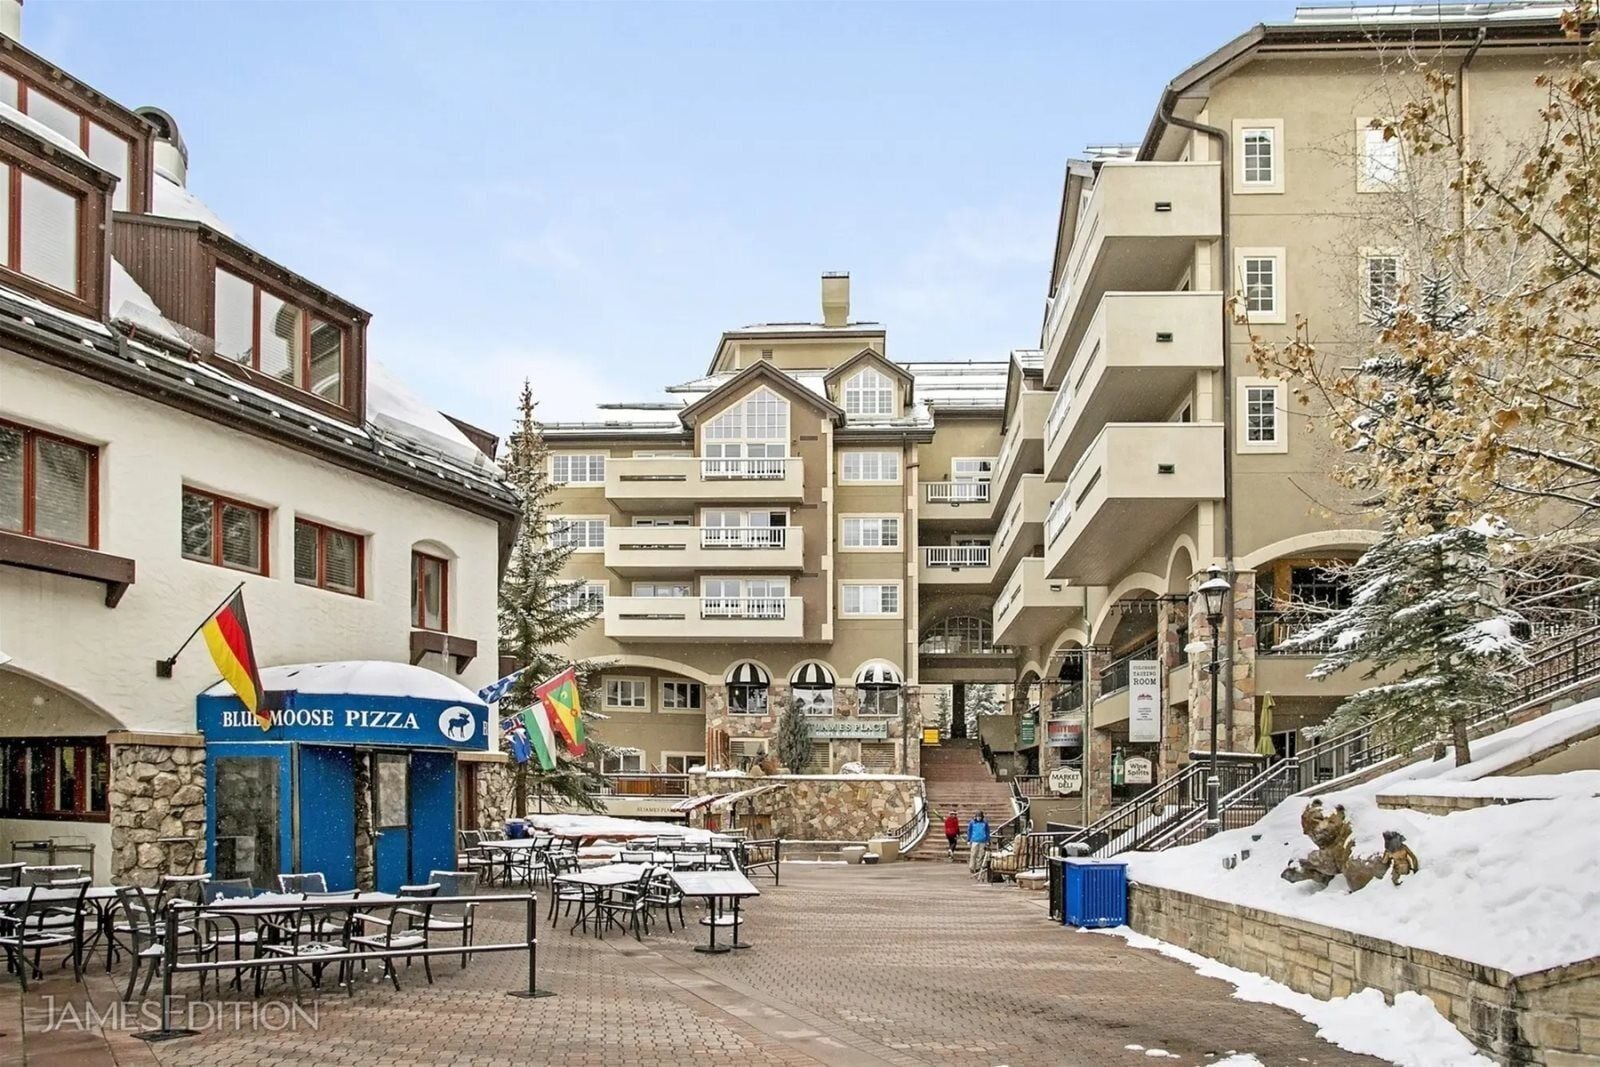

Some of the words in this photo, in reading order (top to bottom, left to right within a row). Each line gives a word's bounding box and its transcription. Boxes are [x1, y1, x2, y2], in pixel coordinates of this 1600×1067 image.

[1133, 678, 1157, 686] ROOM
[269, 709, 334, 726] MOOSE
[344, 709, 420, 730] PIZZA
[816, 723, 852, 732] JAMES
[854, 723, 887, 732] PLACE
